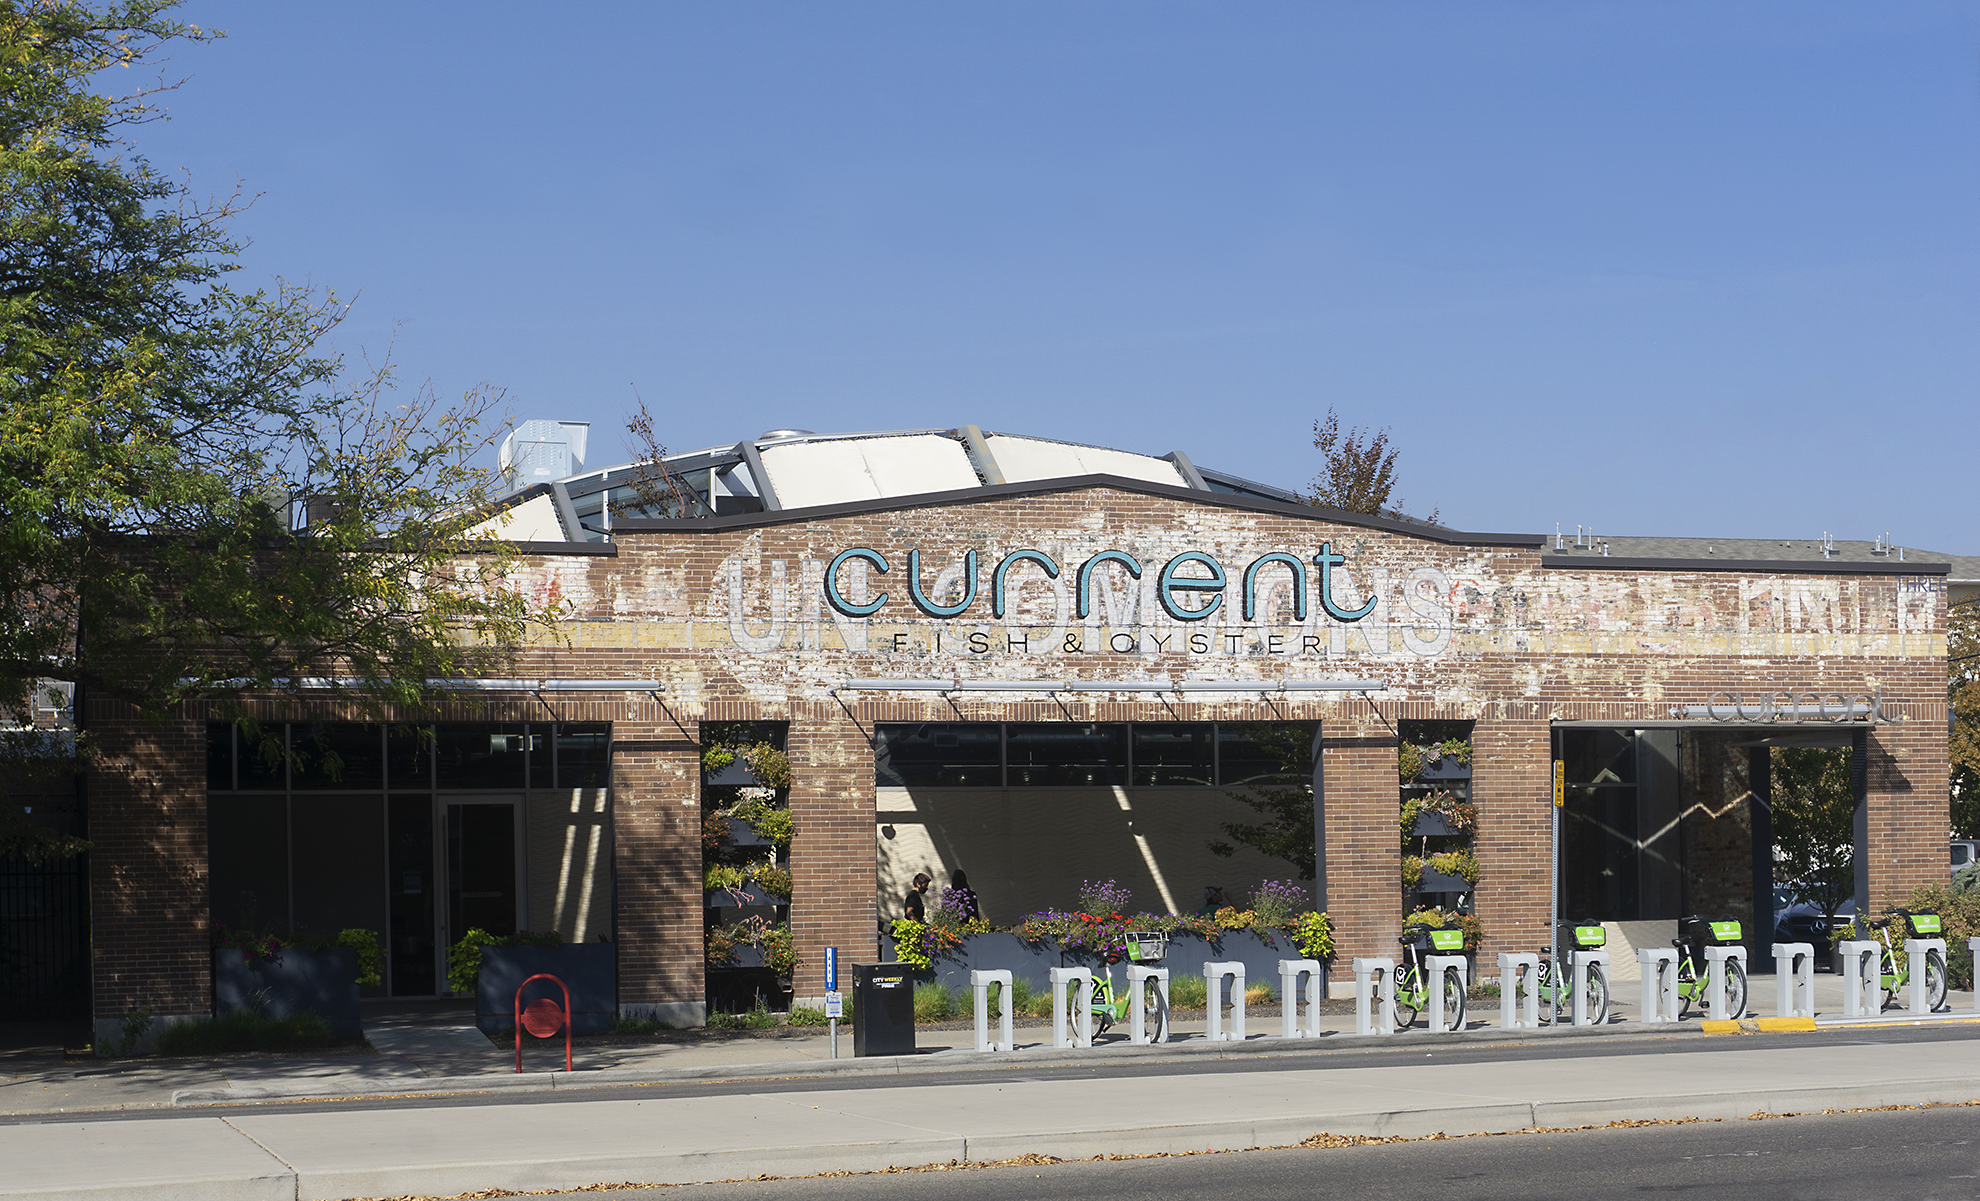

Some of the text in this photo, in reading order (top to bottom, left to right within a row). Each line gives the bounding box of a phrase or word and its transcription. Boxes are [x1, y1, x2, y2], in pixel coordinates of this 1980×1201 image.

[823, 541, 1379, 623] current
[1895, 576, 1948, 593] THREE
[893, 632, 1321, 655] FISH & OYSTER
[1707, 685, 1904, 724] current
